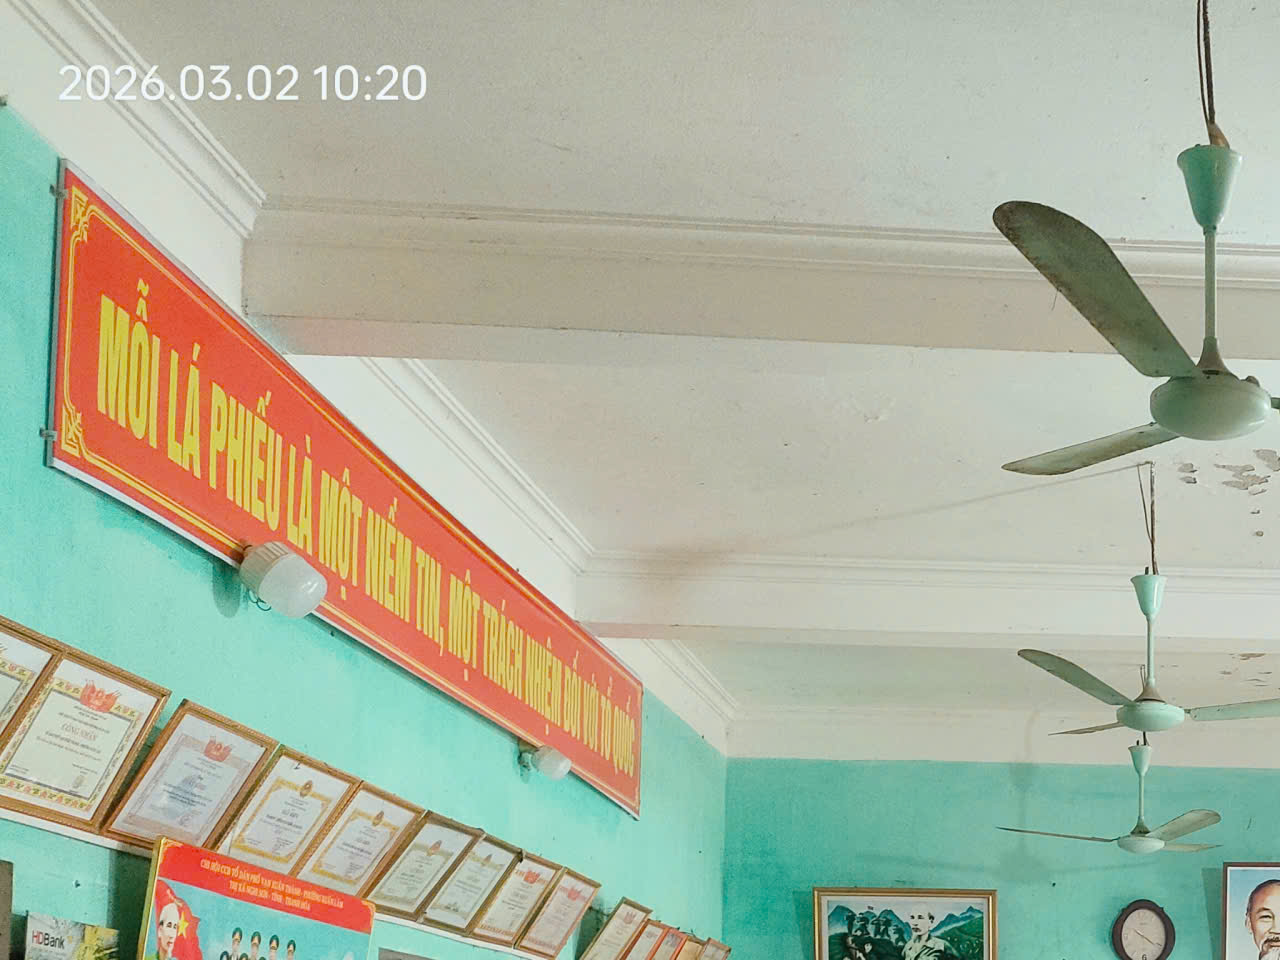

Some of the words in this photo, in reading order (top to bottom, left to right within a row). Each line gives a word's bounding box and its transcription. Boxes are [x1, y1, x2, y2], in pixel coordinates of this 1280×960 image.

[97, 278, 160, 448] MỖI
[167, 342, 201, 480] LÁ
[209, 390, 283, 531] PHIẾU
[287, 434, 313, 556] LÀ
[318, 467, 363, 601] MỘT
[415, 546, 444, 656] TIN,
[448, 568, 480, 681] MỘT
[483, 599, 523, 700] TRÁCH
[525, 636, 562, 736] NHIỆM
[601, 676, 612, 760] TỔ
[613, 695, 635, 778] QUỐC
[32, 930, 65, 949] HDBank
[1141, 953, 1147, 960] 6
